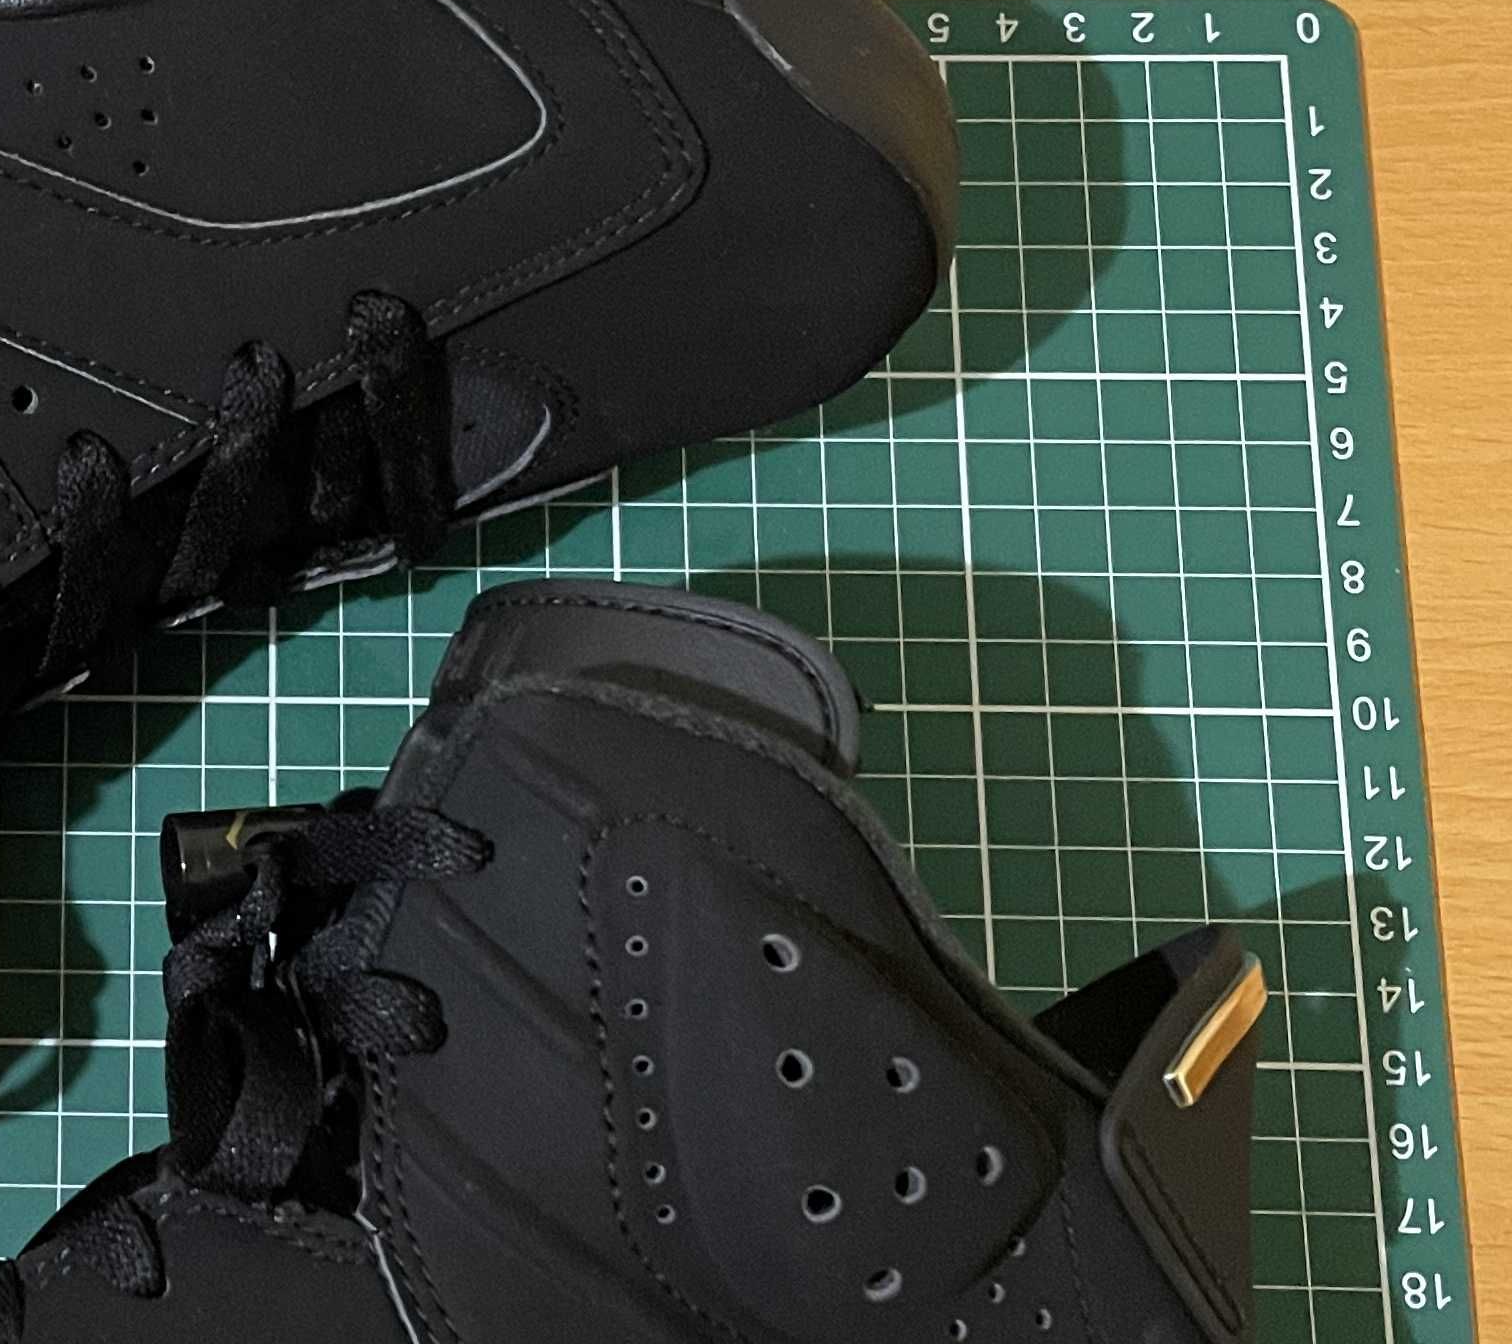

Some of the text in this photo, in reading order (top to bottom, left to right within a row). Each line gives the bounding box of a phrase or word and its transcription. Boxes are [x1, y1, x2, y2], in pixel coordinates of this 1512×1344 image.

[927, 12, 950, 43] 5
[995, 12, 1019, 44] 4
[1062, 11, 1087, 43] 3
[1130, 12, 1155, 44] 2
[1204, 12, 1221, 44] 1
[1296, 12, 1321, 44] 0
[1308, 105, 1325, 137] 1
[1308, 168, 1333, 201] 2
[1313, 231, 1338, 264] 3
[1319, 296, 1344, 329] 4
[1324, 360, 1348, 394] 5
[1329, 426, 1354, 460] 6
[1336, 493, 1361, 527] 7
[1340, 559, 1366, 594] 8
[1346, 627, 1372, 663] 9
[1352, 695, 1400, 731] 10
[1363, 765, 1406, 801] 11
[1363, 835, 1413, 872] 12
[1369, 906, 1419, 943] 13
[1376, 977, 1425, 1014] 14
[1382, 1049, 1432, 1087] 15
[1389, 1122, 1438, 1161] 16
[1397, 1197, 1445, 1235] 17
[1401, 1271, 1452, 1311] 18
